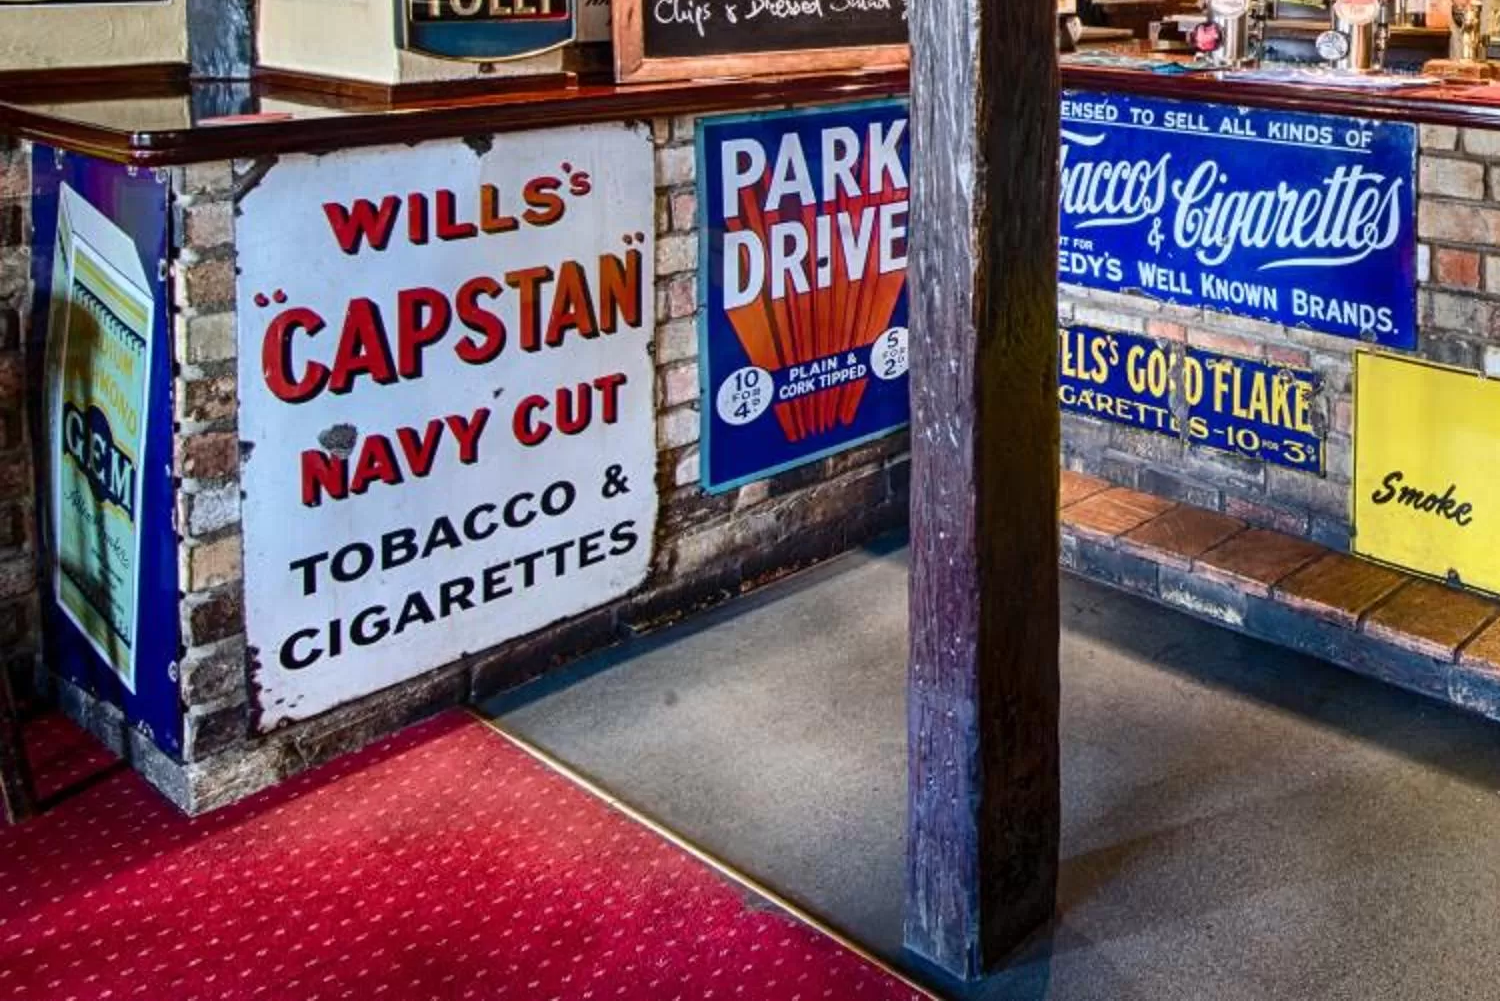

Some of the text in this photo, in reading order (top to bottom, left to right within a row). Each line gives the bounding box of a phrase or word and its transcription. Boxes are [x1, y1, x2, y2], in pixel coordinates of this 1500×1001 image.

[1129, 107, 1156, 126] TO
[1163, 110, 1210, 133] SELL
[1218, 118, 1257, 138] ALL
[1267, 120, 1335, 145] KINDS
[1345, 129, 1374, 149] OF
[721, 119, 908, 220] PARK
[1073, 238, 1094, 251] FOR
[1147, 217, 1166, 254] &
[1171, 159, 1404, 271] Cigarettes
[723, 200, 908, 311] DRIVE
[1137, 259, 1193, 296] WELL
[1200, 273, 1279, 312] KNOWN
[1292, 289, 1400, 336] BRANDS.
[734, 368, 760, 392] 10
[778, 363, 868, 401] CORK TIPPED
[789, 352, 858, 382] PLAIN &
[300, 371, 628, 508] NAVY CUT
[288, 462, 631, 598] TOBACCO &
[1372, 469, 1474, 528] Smoke
[278, 519, 640, 673] CIGARETTES
